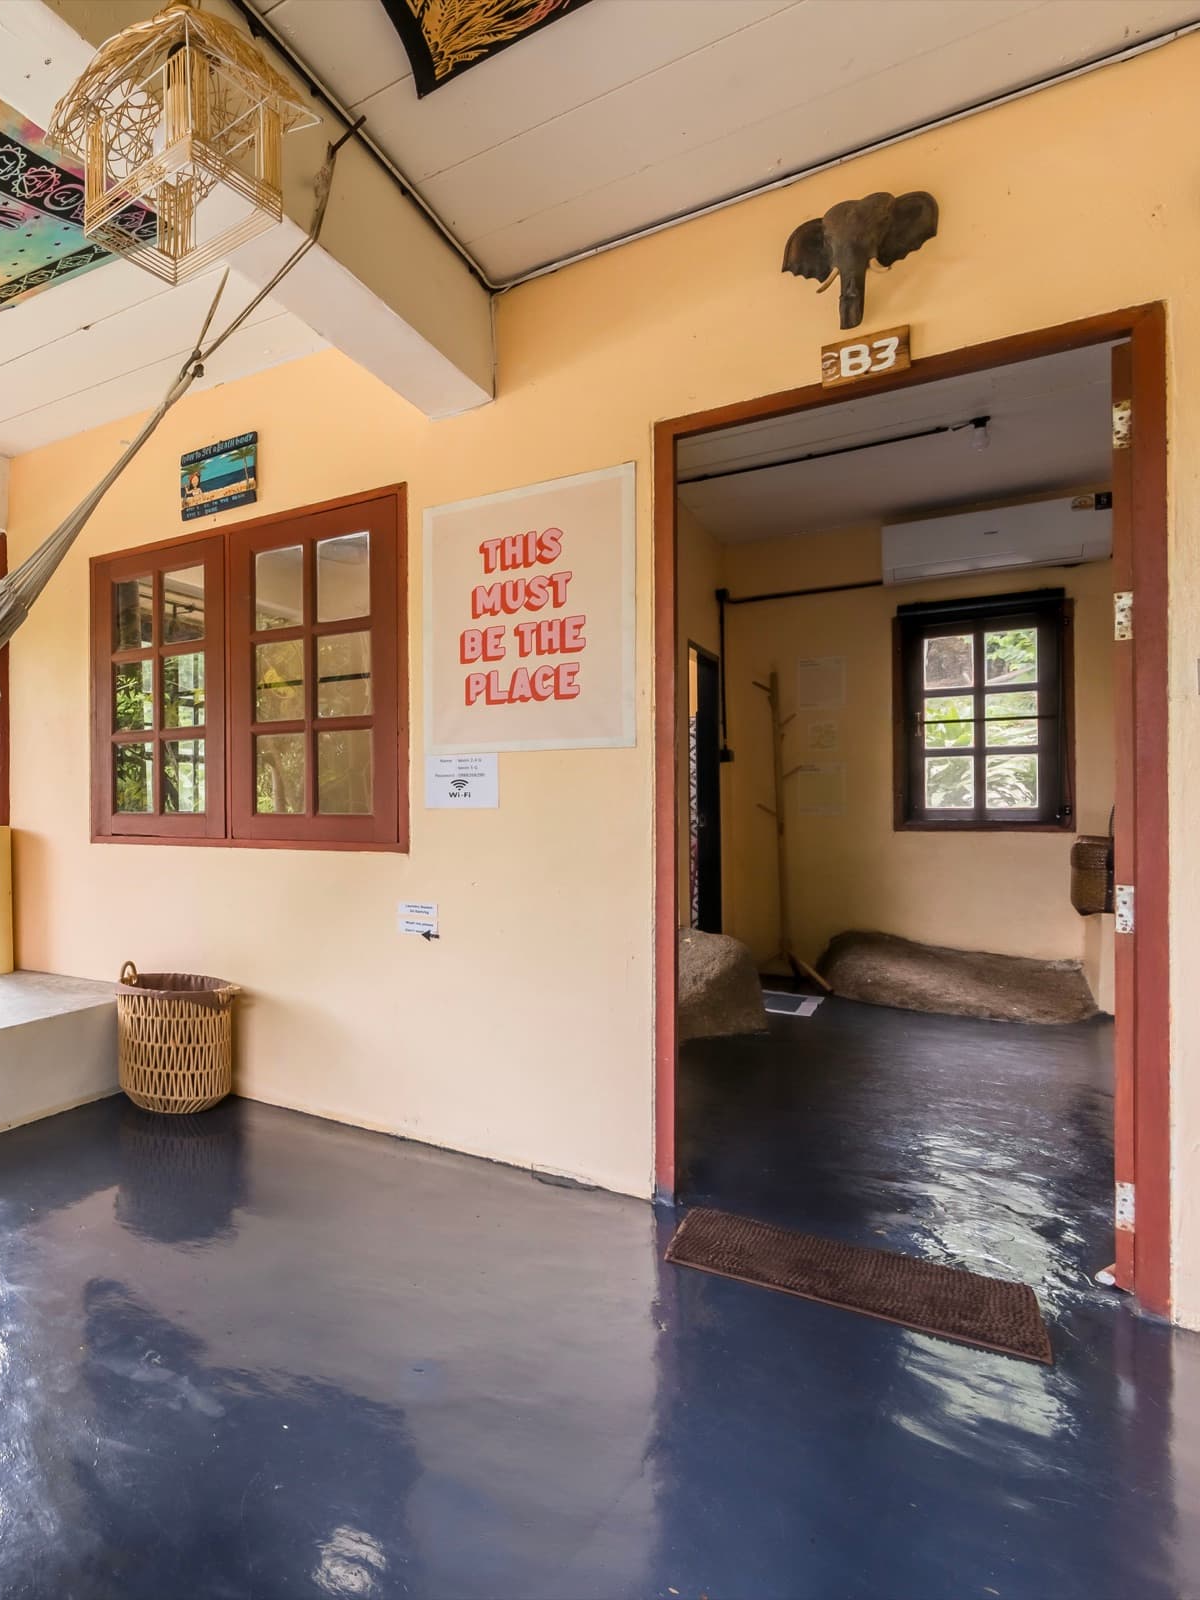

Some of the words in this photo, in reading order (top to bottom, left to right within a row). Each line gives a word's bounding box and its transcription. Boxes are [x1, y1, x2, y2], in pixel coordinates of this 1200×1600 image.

[840, 336, 899, 377] B3
[479, 528, 563, 574] THIS
[472, 571, 572, 619] MUST
[460, 626, 506, 664] BE
[514, 615, 586, 657] THE
[465, 662, 580, 706] PLACE
